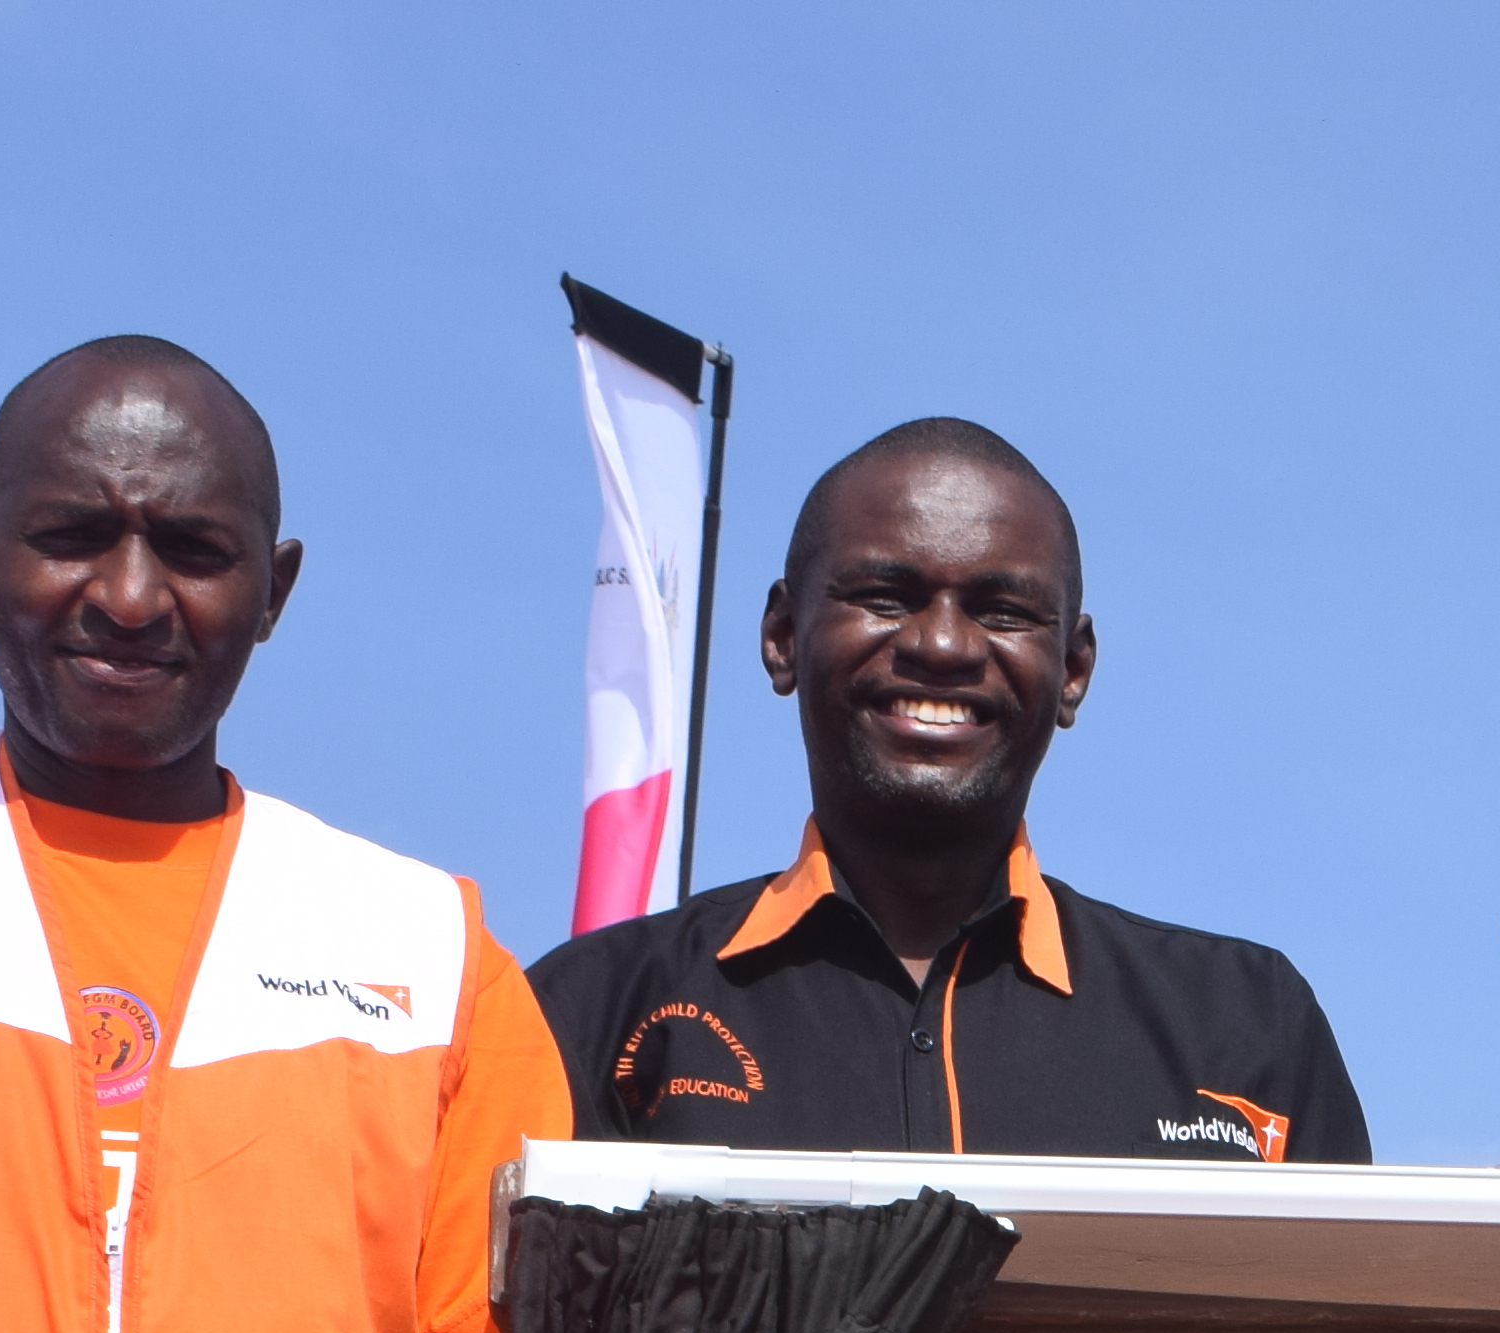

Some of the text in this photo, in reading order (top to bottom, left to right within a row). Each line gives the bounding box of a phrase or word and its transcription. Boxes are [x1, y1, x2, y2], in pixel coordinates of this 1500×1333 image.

[257, 973, 329, 997] World
[83, 992, 155, 1041] FGM BOARD
[650, 1002, 699, 1024] CHILD
[701, 1010, 765, 1091] PROTECTION
[669, 1077, 750, 1104] EDUCATION
